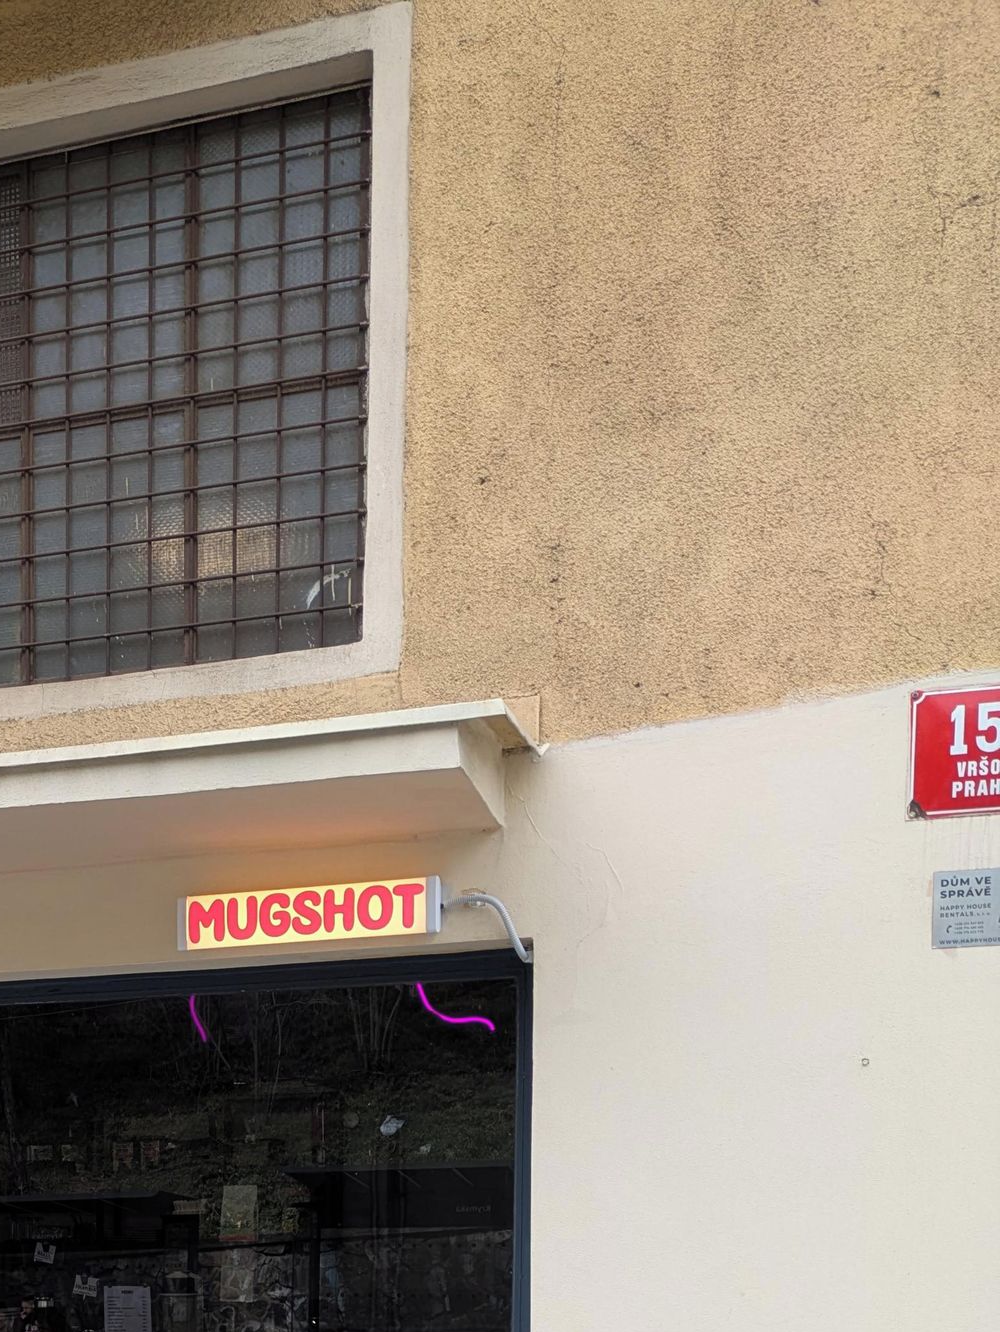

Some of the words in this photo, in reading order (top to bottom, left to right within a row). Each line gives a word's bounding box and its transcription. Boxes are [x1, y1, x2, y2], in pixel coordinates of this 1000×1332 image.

[949, 701, 1000, 756] 15
[956, 756, 1000, 778] VRŠO
[951, 778, 1000, 799] PRAH
[940, 875, 970, 888] DŮM
[975, 876, 992, 885] VE
[939, 886, 992, 899] SPRÁVĚ
[187, 882, 425, 944] MUGSHOT
[966, 902, 992, 910] HOUSE
